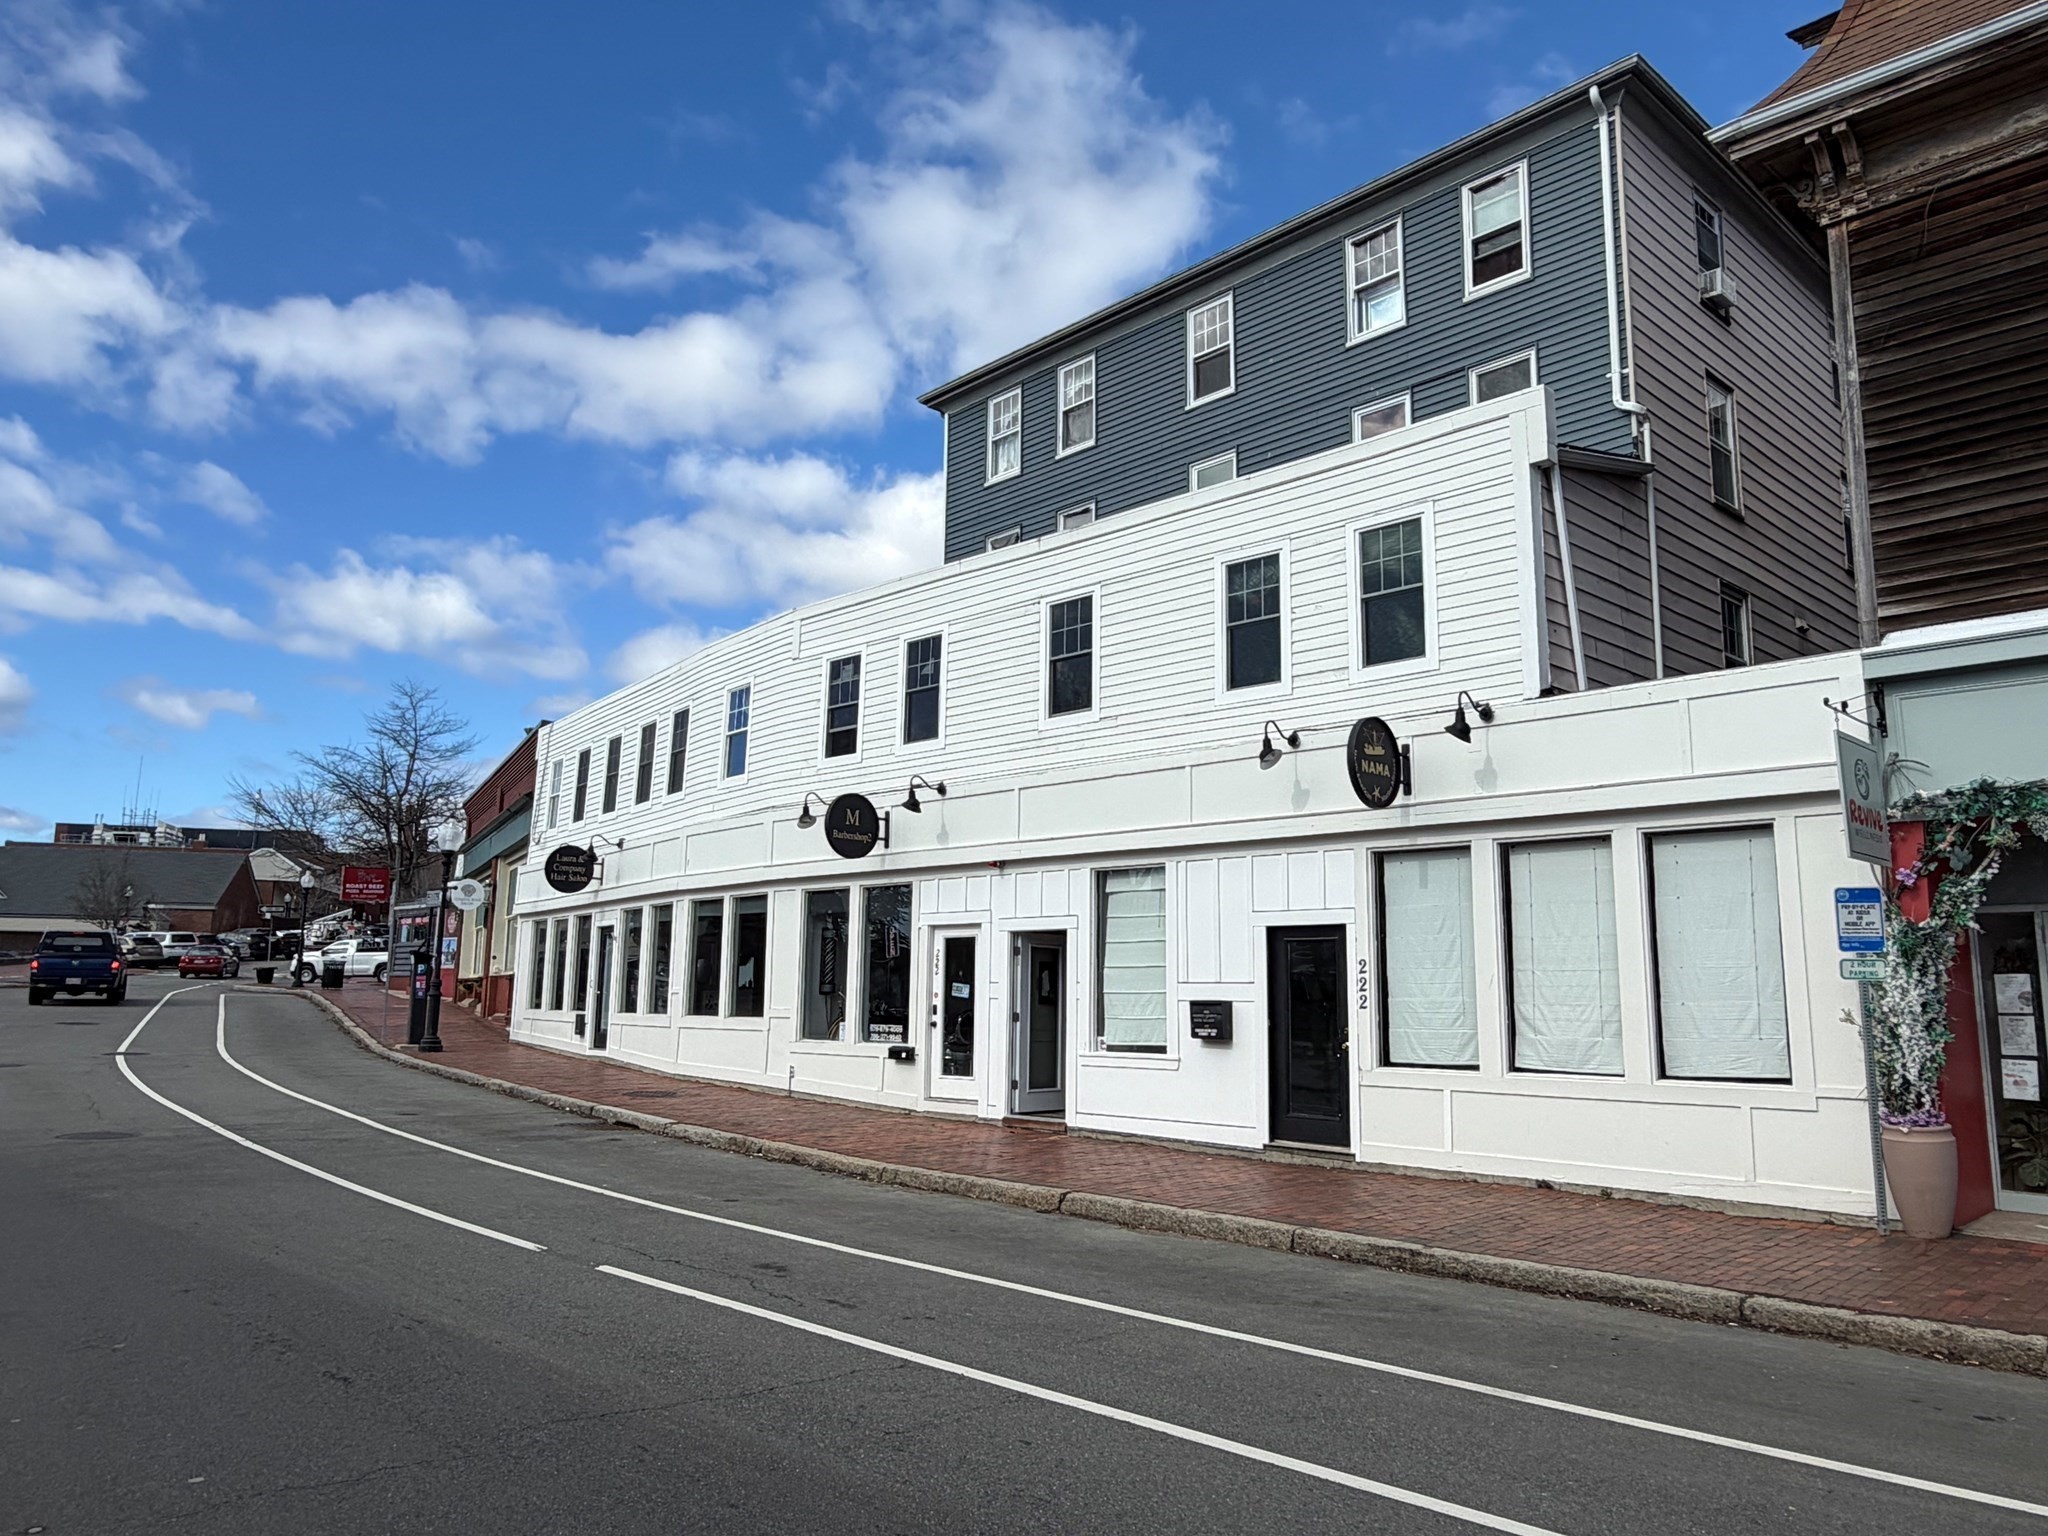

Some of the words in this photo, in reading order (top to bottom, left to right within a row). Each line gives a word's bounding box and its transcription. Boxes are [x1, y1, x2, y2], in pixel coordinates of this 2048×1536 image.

[1361, 758, 1391, 778] NAMA
[845, 808, 860, 826] M
[556, 853, 577, 863] Laura
[553, 863, 587, 875] Company
[550, 872, 567, 881] Hair
[568, 874, 588, 882] Salon
[1358, 958, 1368, 1010] 222
